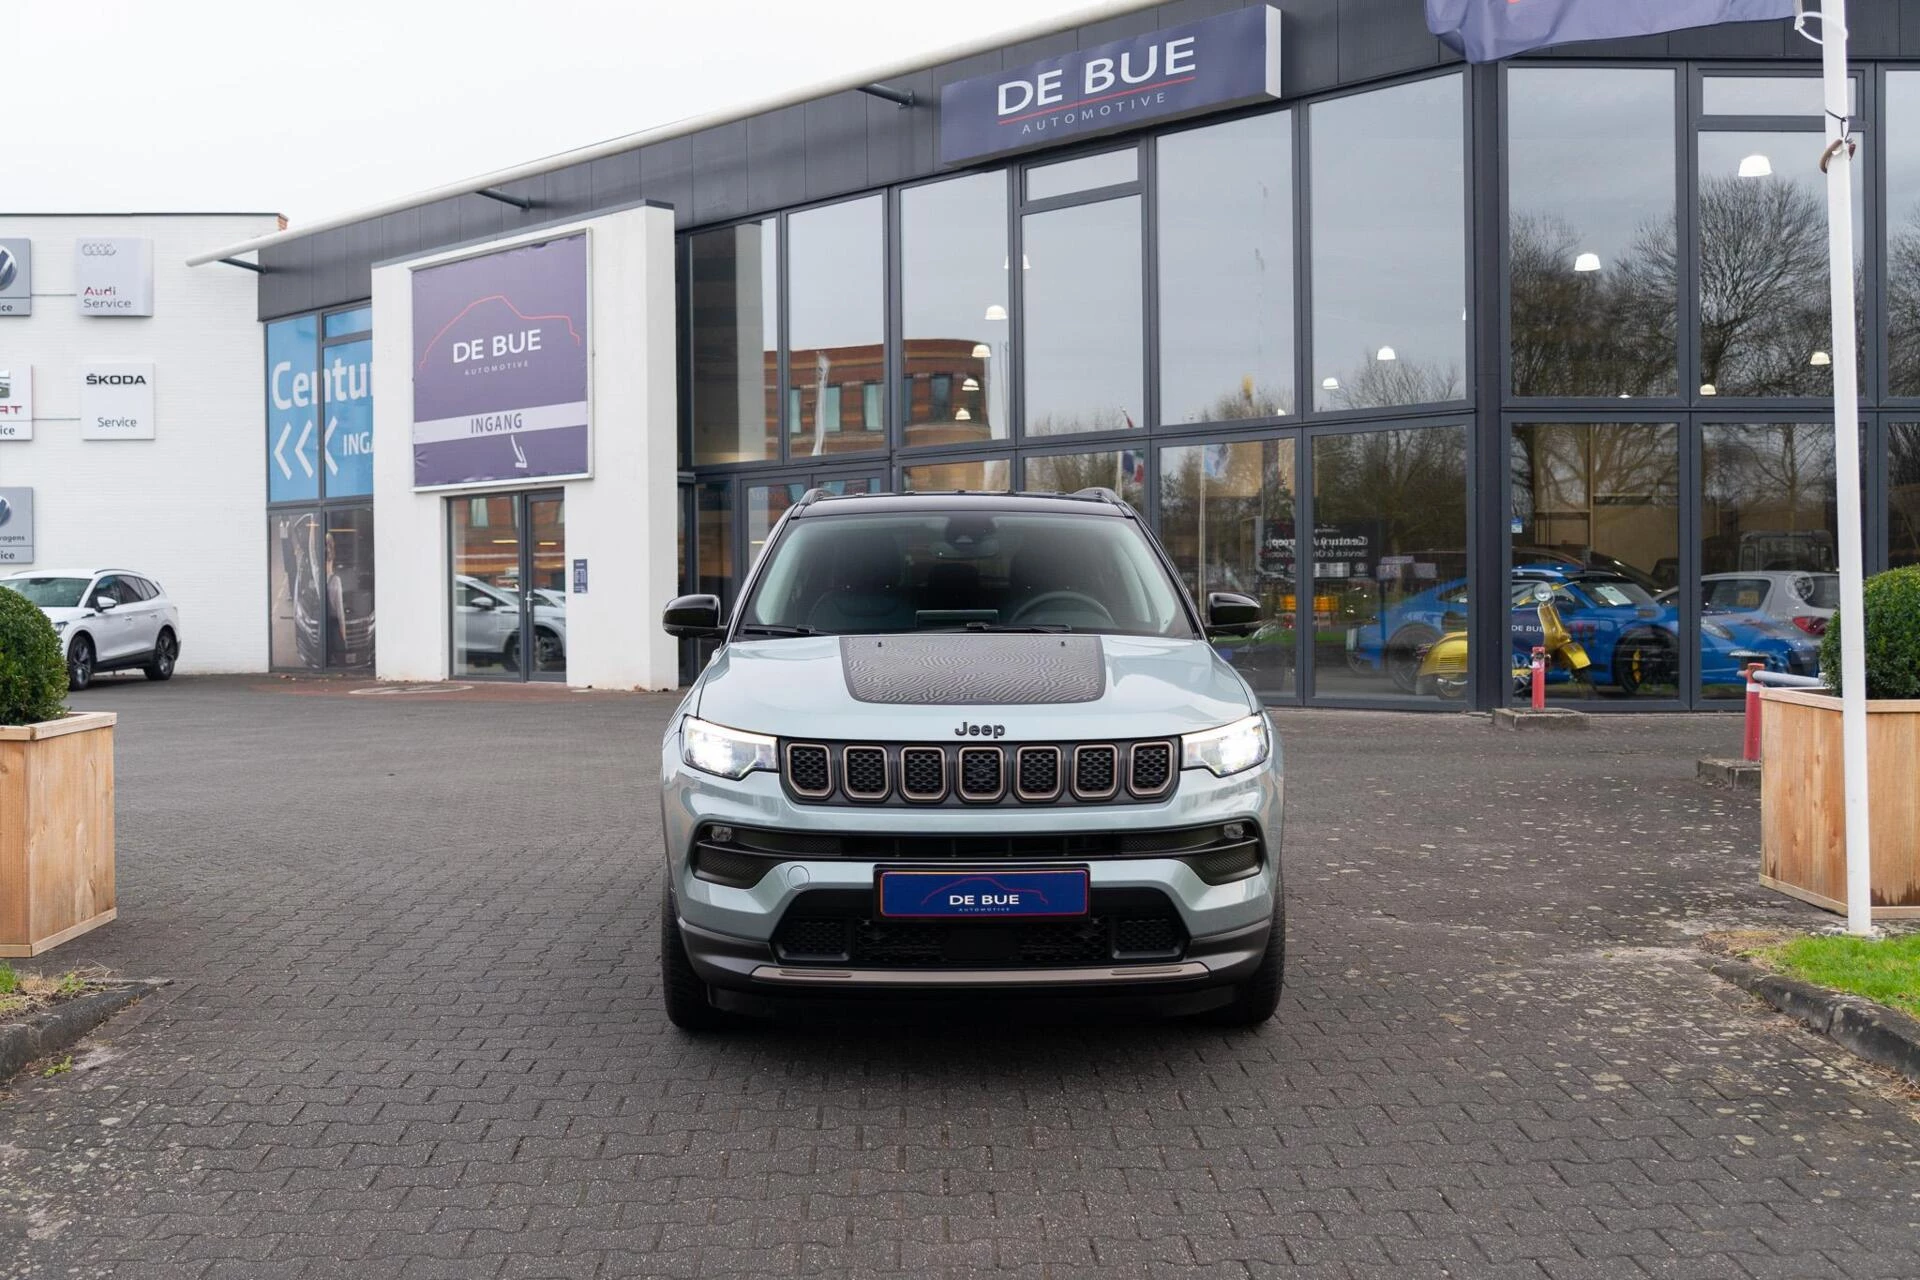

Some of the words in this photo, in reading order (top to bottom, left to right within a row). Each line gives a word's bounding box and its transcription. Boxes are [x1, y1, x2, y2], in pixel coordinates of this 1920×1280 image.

[997, 69, 1064, 117] DE
[1084, 36, 1197, 95] BUE
[1021, 91, 1167, 135] AUTOMOTIVE
[84, 286, 116, 297] Audi
[83, 298, 132, 309] Service
[453, 338, 485, 364] DE
[492, 328, 542, 357] BUE
[464, 359, 529, 376] AUTOMOTIVE
[86, 373, 147, 386] ŠKODA
[272, 357, 374, 411] Centu
[97, 416, 137, 428] Service
[470, 412, 523, 434] INGANG
[343, 431, 374, 457] ING
[954, 721, 1006, 739] Jeep
[949, 894, 975, 906] DE
[981, 893, 1021, 905] BUE
